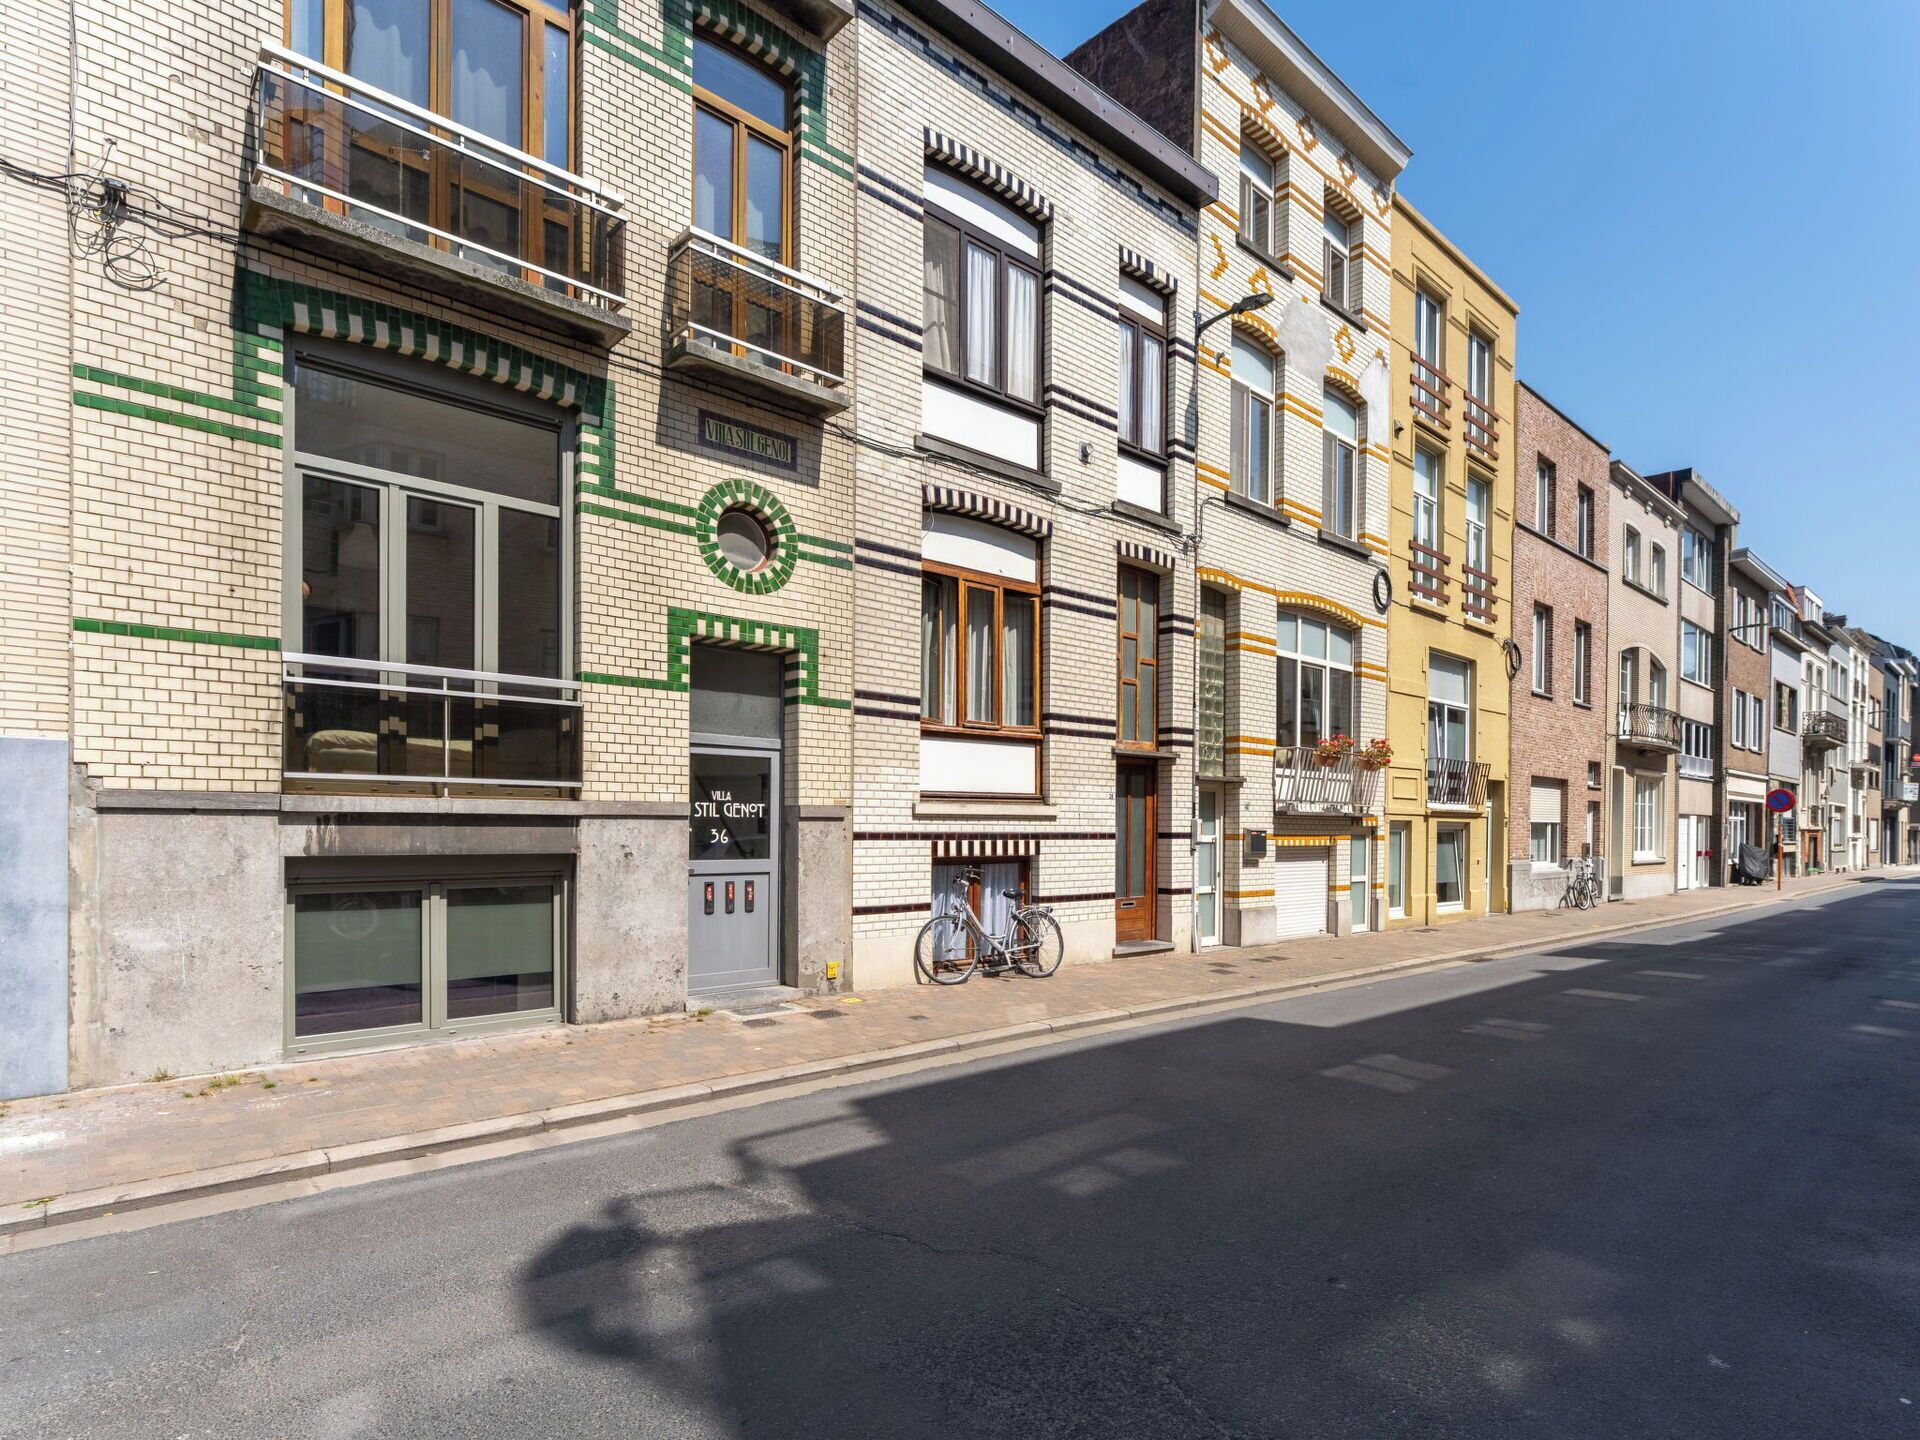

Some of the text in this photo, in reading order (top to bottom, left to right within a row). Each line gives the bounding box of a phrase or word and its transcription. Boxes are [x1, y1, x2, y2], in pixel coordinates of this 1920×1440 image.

[711, 790, 732, 801] VILLA
[694, 802, 765, 818] STIL GENOT
[710, 828, 729, 844] 36
